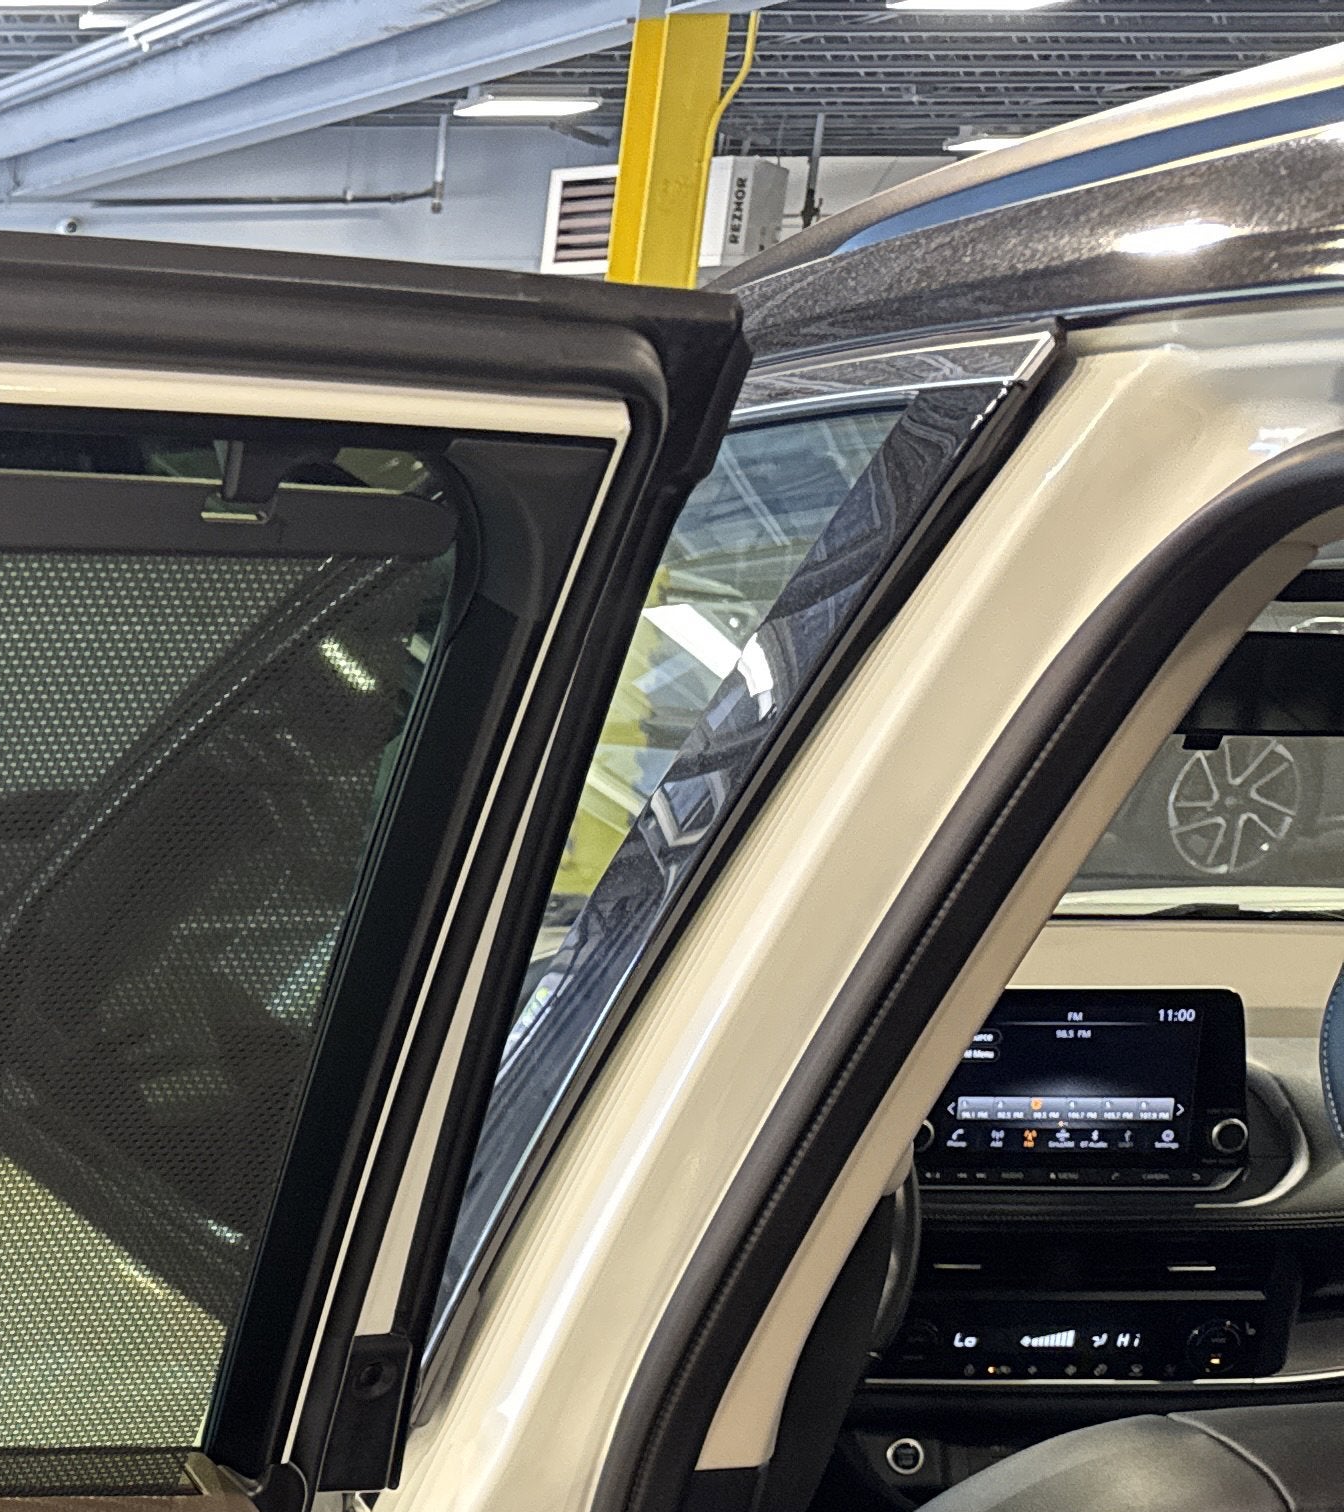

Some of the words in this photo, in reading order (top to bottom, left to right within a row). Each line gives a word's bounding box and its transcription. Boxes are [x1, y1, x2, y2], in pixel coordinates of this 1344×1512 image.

[728, 177, 748, 244] REZNOR
[1067, 1011, 1083, 1021] FM
[1158, 1008, 1196, 1022] 11:00
[1077, 1029, 1092, 1038] FM
[1116, 1332, 1141, 1347] Hi
